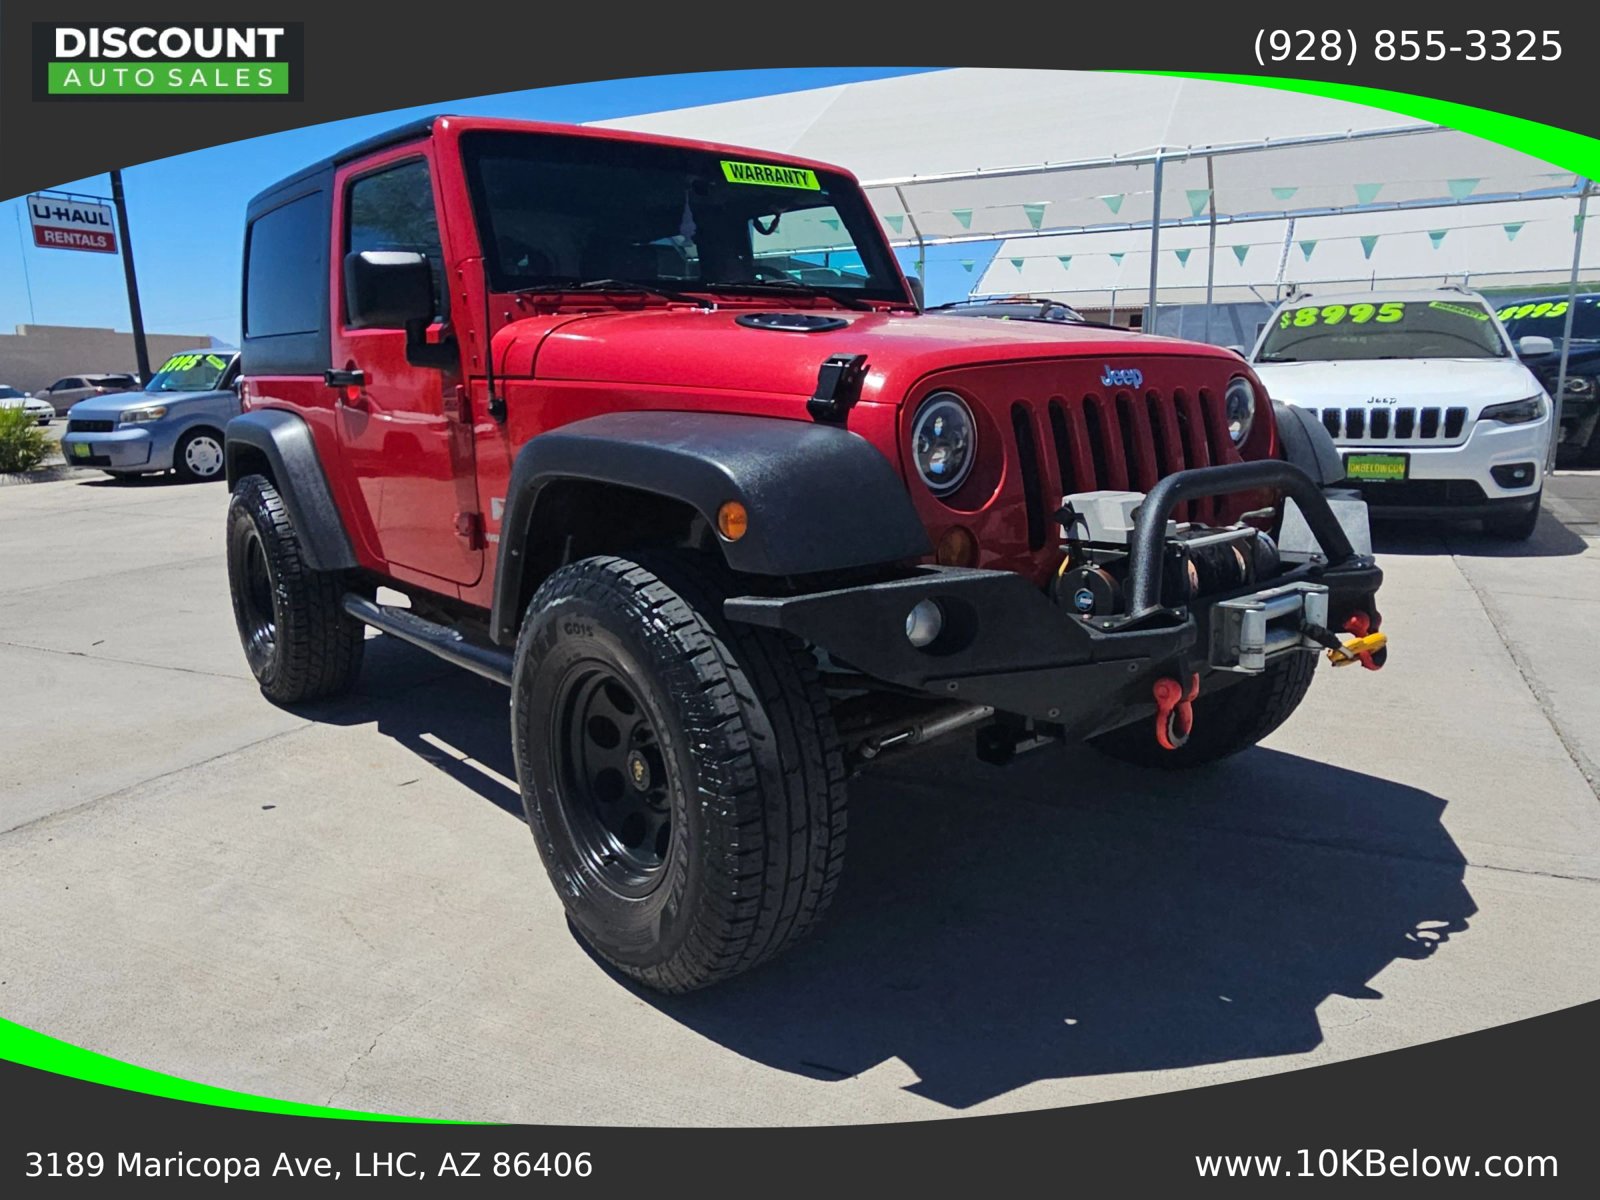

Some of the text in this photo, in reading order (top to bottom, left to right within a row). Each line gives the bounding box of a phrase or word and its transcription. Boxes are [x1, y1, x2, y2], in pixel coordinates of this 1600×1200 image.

[729, 163, 809, 185] WARRANTY
[33, 204, 110, 226] U-HAUL
[44, 230, 107, 248] RENTALS
[1280, 302, 1405, 329] $8995
[1100, 364, 1143, 389] Jeep
[1366, 396, 1397, 405] Jeep
